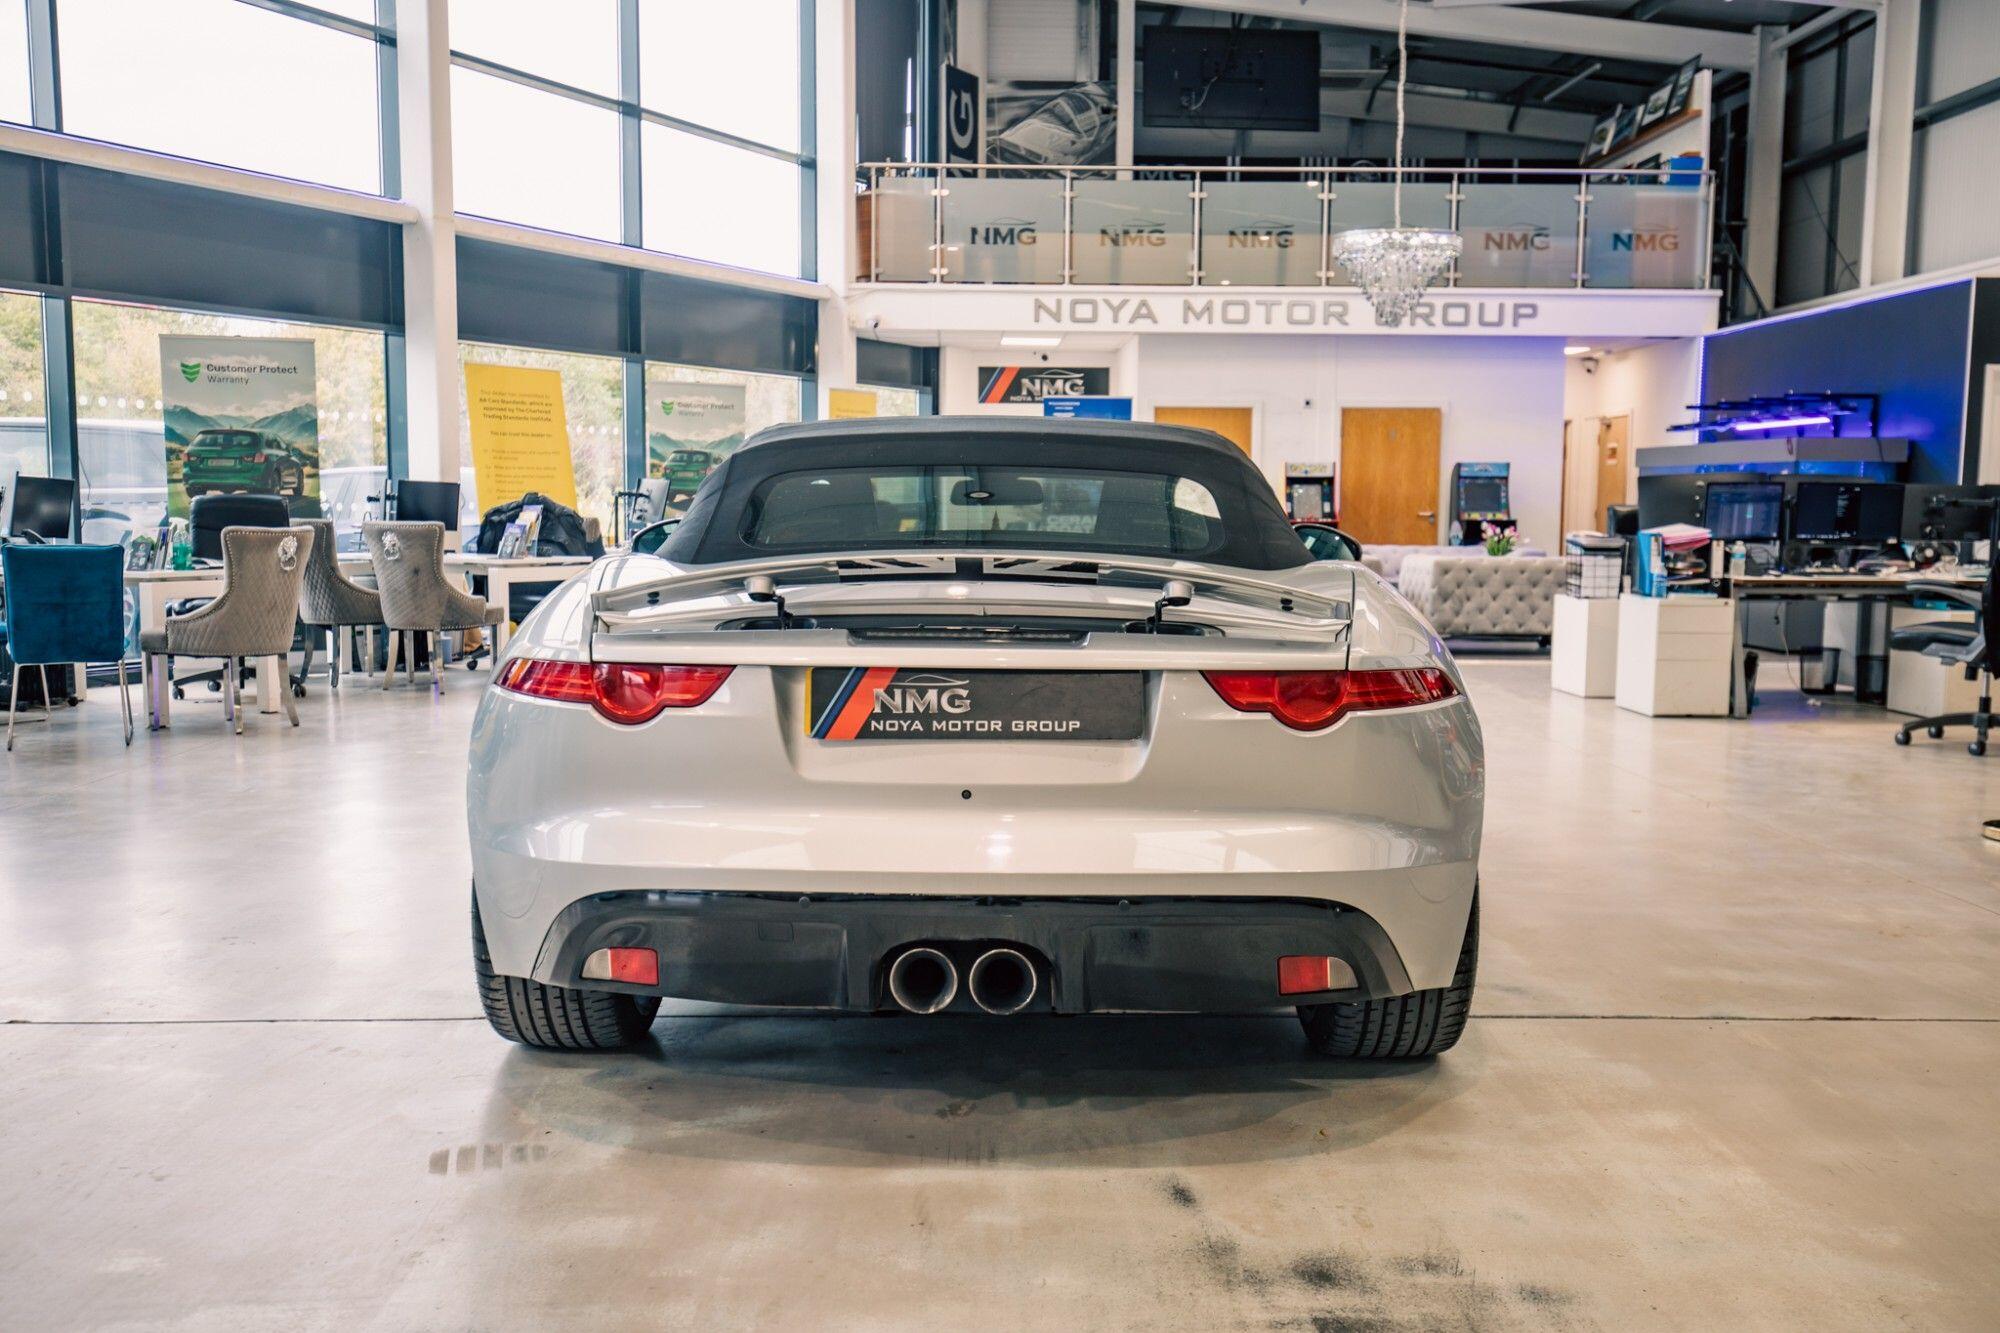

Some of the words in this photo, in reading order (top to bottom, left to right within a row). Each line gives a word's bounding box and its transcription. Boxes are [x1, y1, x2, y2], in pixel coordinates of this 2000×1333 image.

[970, 226, 1038, 246] NMG
[1100, 228, 1167, 247] NMG
[1228, 229, 1296, 248] NMG
[1484, 232, 1552, 251] NMG
[1612, 232, 1680, 252] NMG
[1034, 298, 1158, 324] NOYA
[1182, 299, 1349, 325] MOTOR
[206, 363, 257, 373] Customer
[259, 364, 298, 374] Protect
[207, 375, 250, 385] Warranty
[1020, 378, 1085, 396] NMG
[872, 687, 971, 714] NMG
[871, 719, 923, 732] NOYA
[932, 719, 1002, 732] MOTOR
[1012, 720, 1081, 732] GROUP
